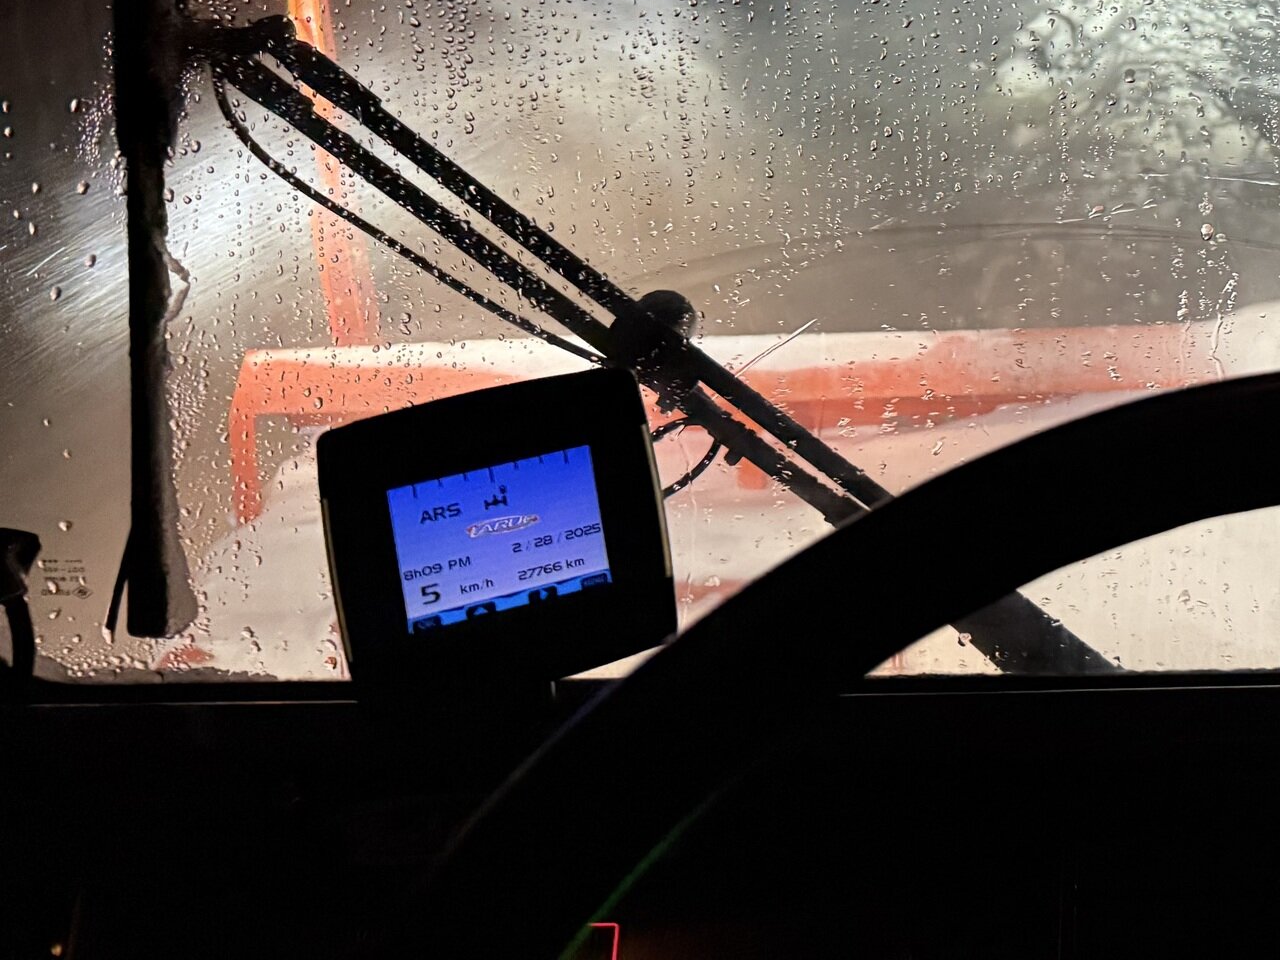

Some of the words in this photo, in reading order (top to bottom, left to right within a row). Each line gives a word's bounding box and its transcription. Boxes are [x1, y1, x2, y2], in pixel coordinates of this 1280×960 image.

[420, 502, 461, 524] ARS
[512, 542, 522, 553] 2
[534, 535, 553, 548] 28
[564, 523, 601, 540] 2025
[403, 563, 443, 581] 8h09
[448, 556, 471, 570] PM
[517, 561, 563, 581] 27766
[566, 558, 585, 569] km
[420, 583, 441, 605] 5
[460, 579, 494, 595] km/h
